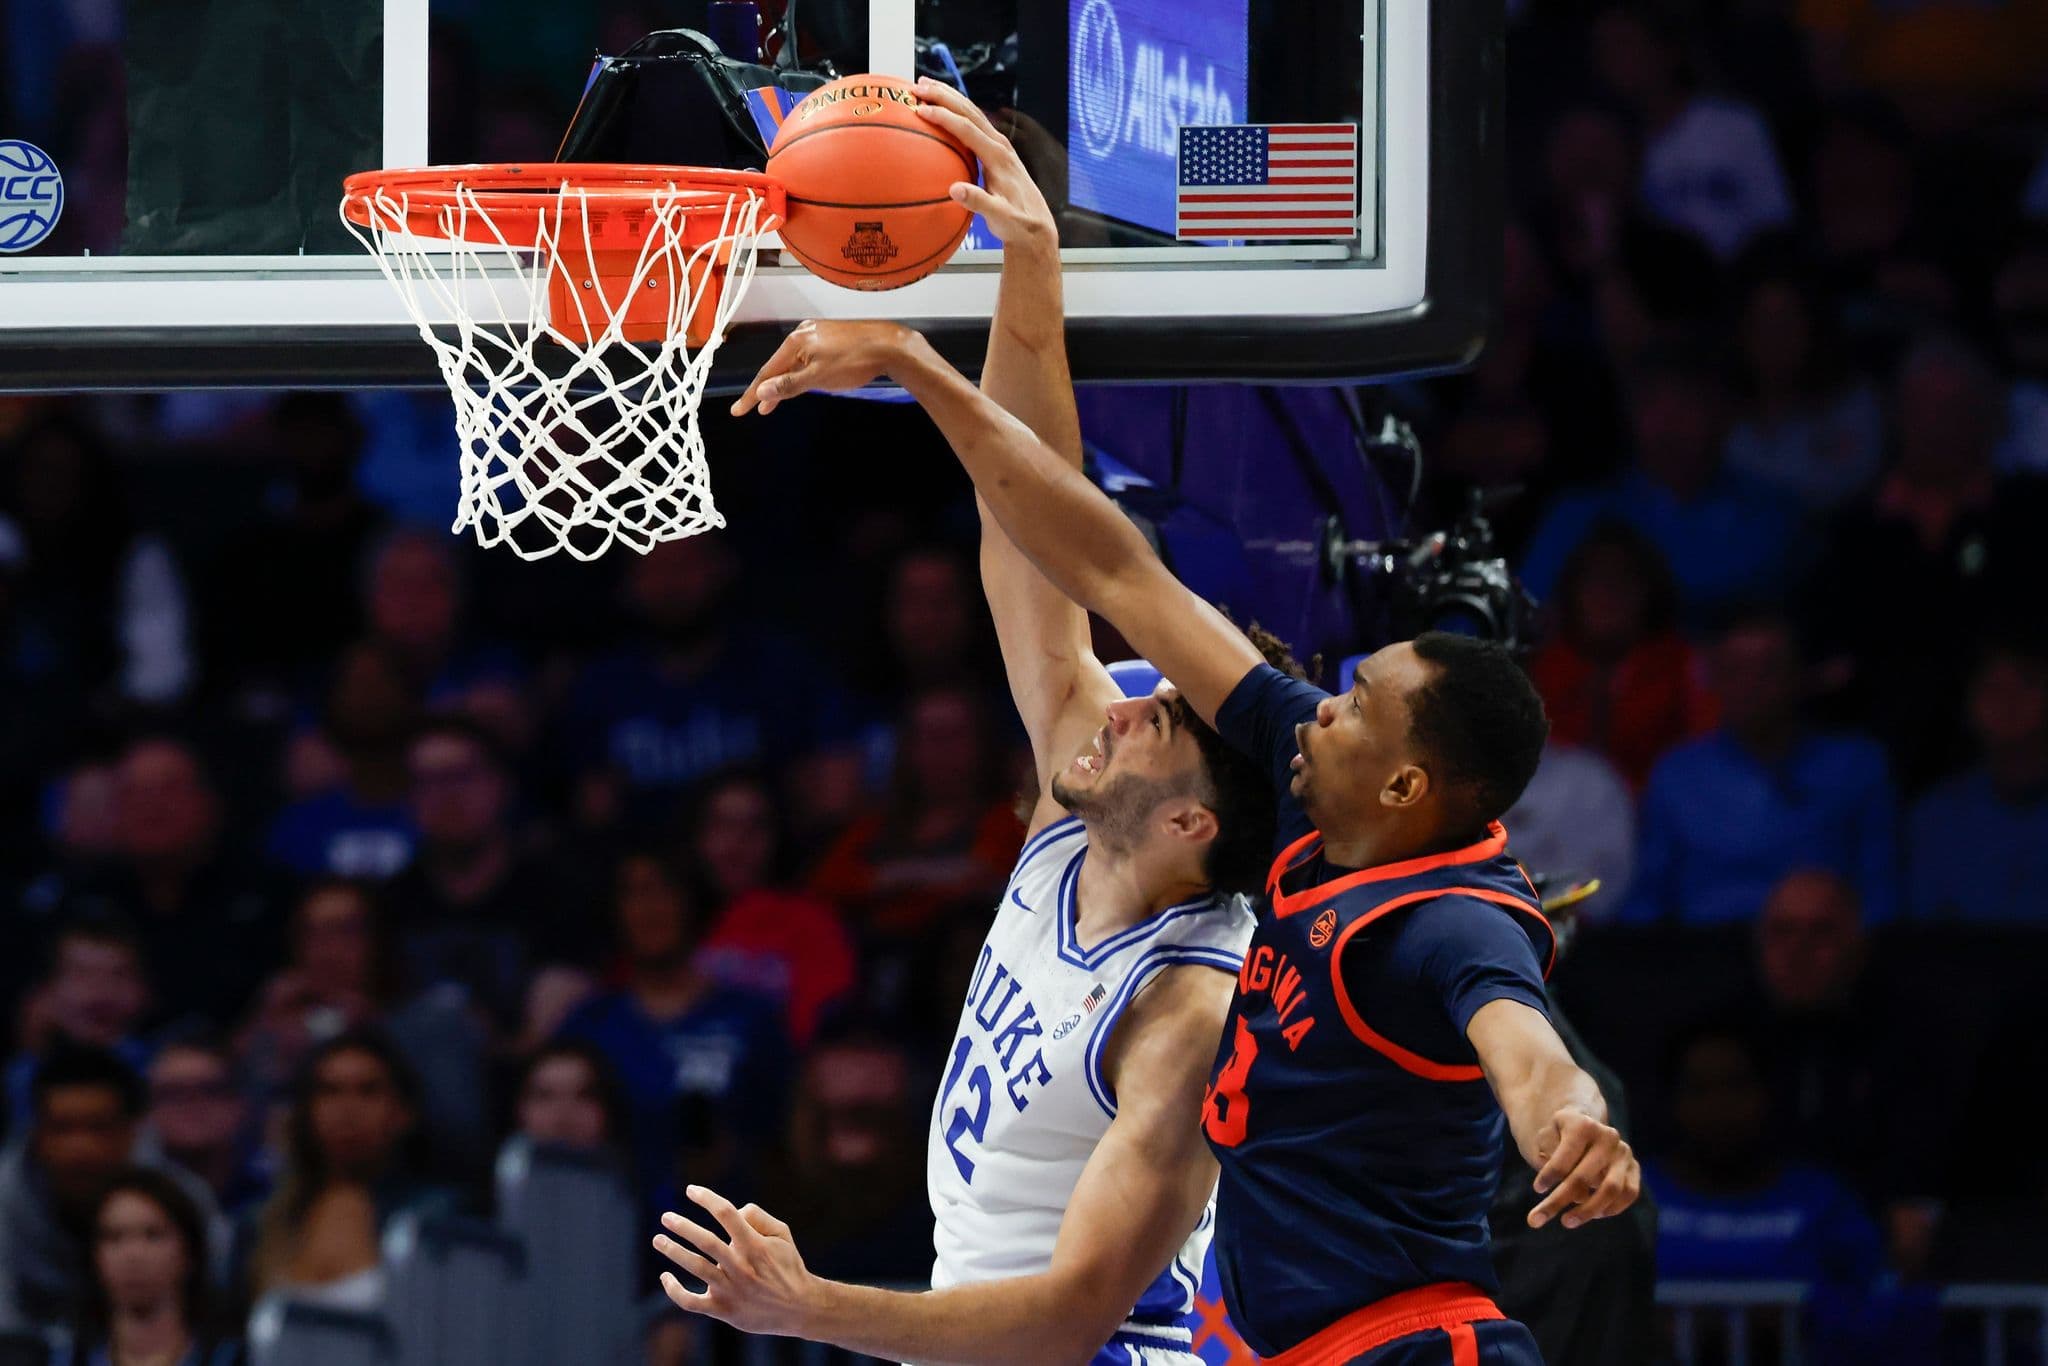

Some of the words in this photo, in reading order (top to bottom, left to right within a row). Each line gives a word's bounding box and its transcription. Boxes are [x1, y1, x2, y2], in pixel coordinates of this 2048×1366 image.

[801, 84, 921, 120] PALDING
[967, 943, 1053, 1113] DUKE
[940, 1035, 992, 1185] 12
